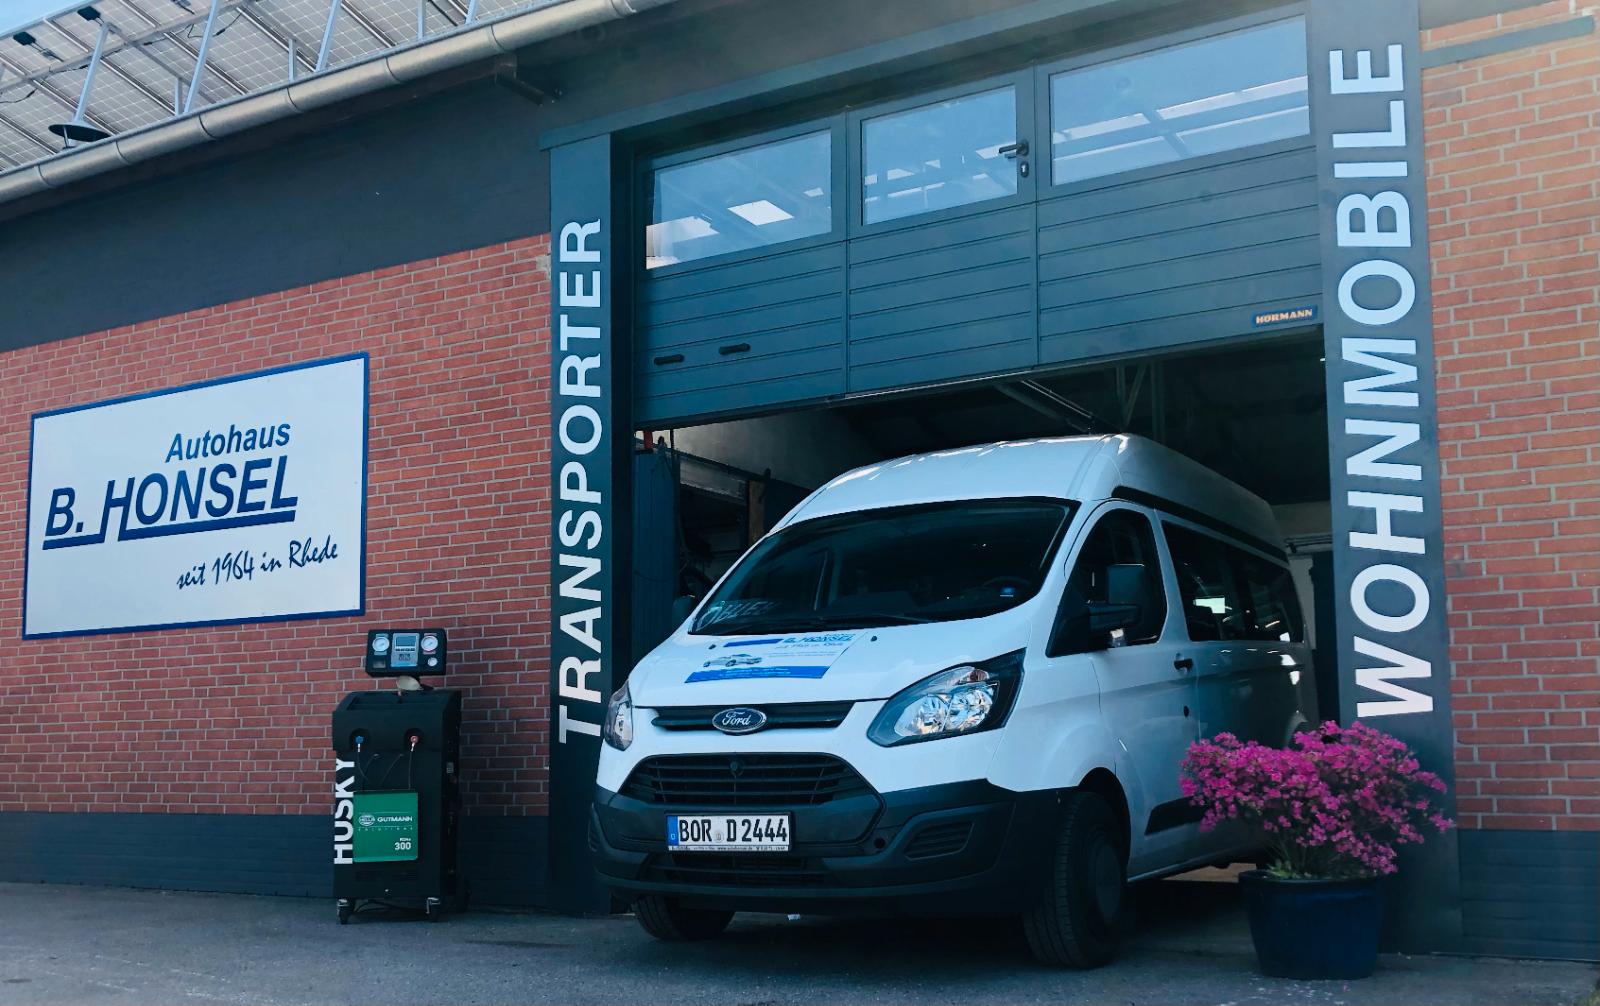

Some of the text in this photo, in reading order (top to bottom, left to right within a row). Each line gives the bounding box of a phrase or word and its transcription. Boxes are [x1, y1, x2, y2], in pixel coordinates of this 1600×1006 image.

[1329, 43, 1434, 718] WOHNMOBILE
[165, 422, 291, 463] Autohaus
[45, 455, 298, 542] B. HONSEL
[558, 218, 603, 745] TRANSPORTER
[176, 534, 339, 590] seit 1964 in Rhede
[721, 711, 752, 726] Ford
[334, 758, 355, 865] HUSKY
[679, 819, 712, 842] BOR
[726, 819, 737, 842] D
[741, 818, 787, 842] 2444
[394, 842, 411, 851] 300
